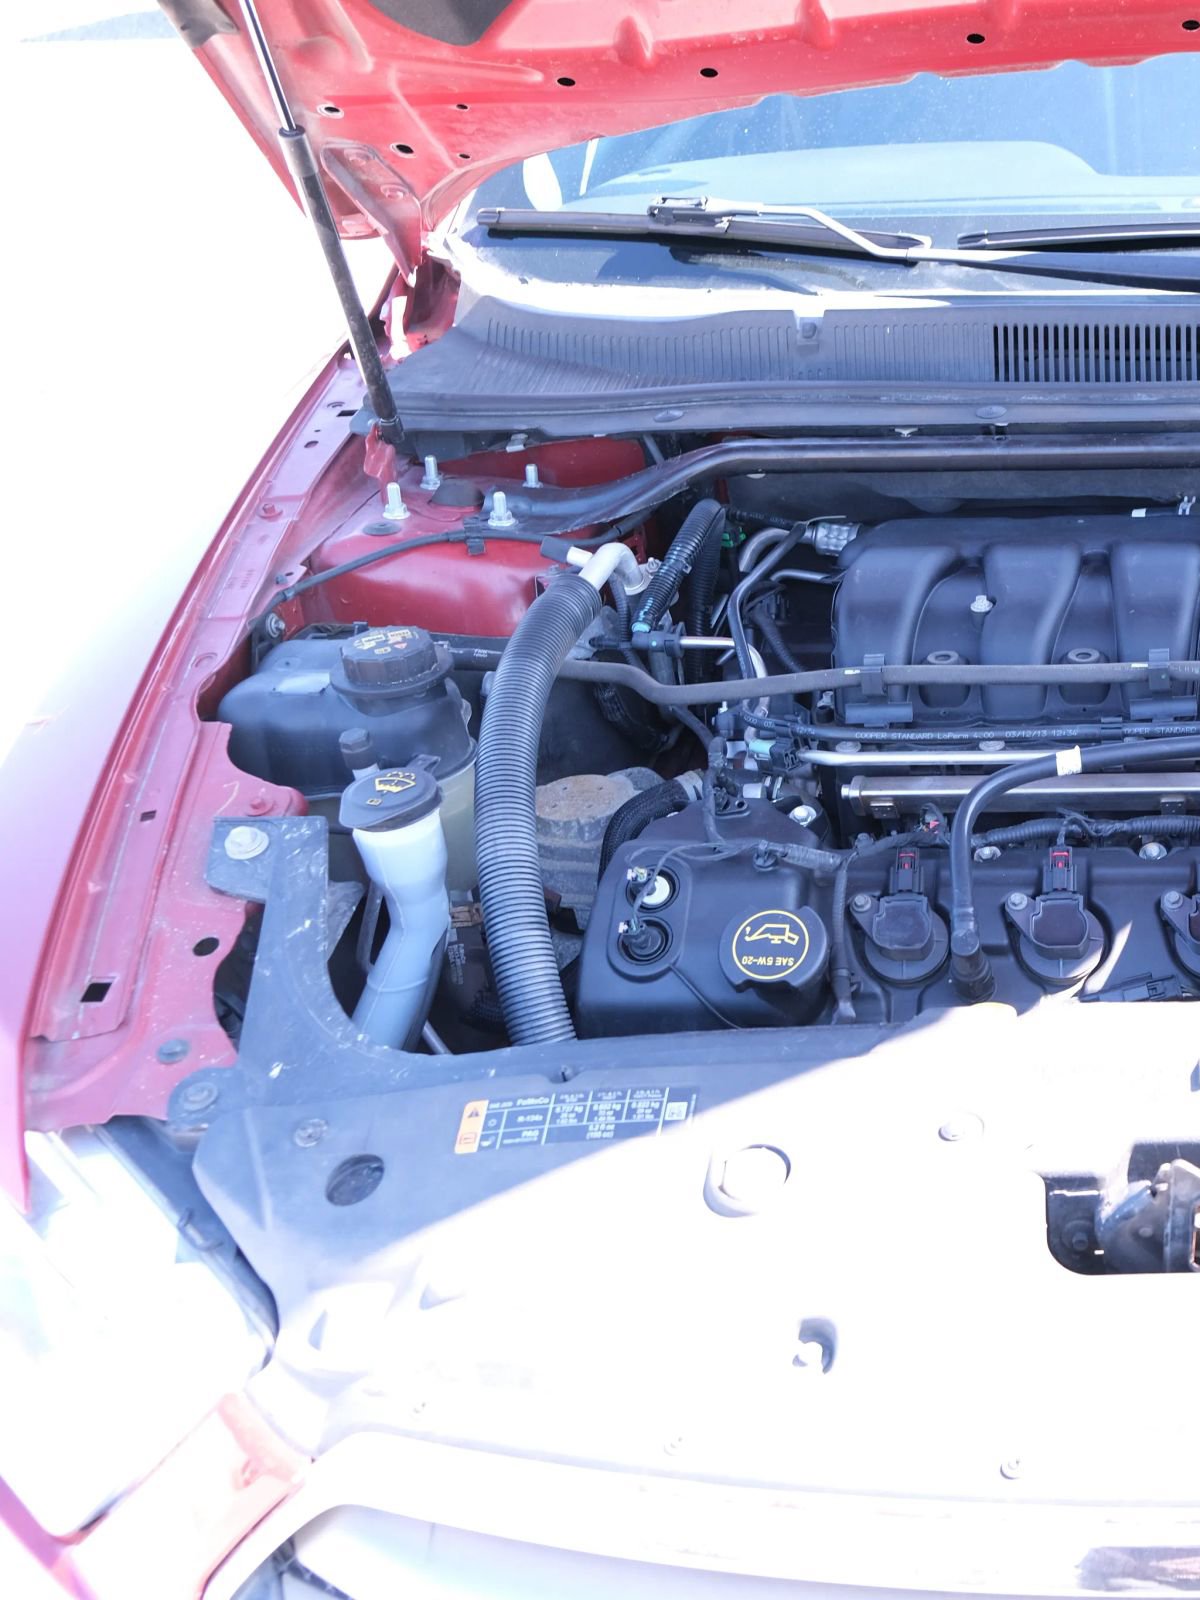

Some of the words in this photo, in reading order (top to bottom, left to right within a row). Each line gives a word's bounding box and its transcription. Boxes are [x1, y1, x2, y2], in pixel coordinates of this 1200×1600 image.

[855, 731, 888, 740] COOPER
[892, 731, 934, 740] STANDARD
[937, 731, 969, 740] LoPerm
[1004, 729, 1048, 739] 03/12/13
[742, 955, 774, 966] 5W-20
[775, 956, 795, 967] SAE
